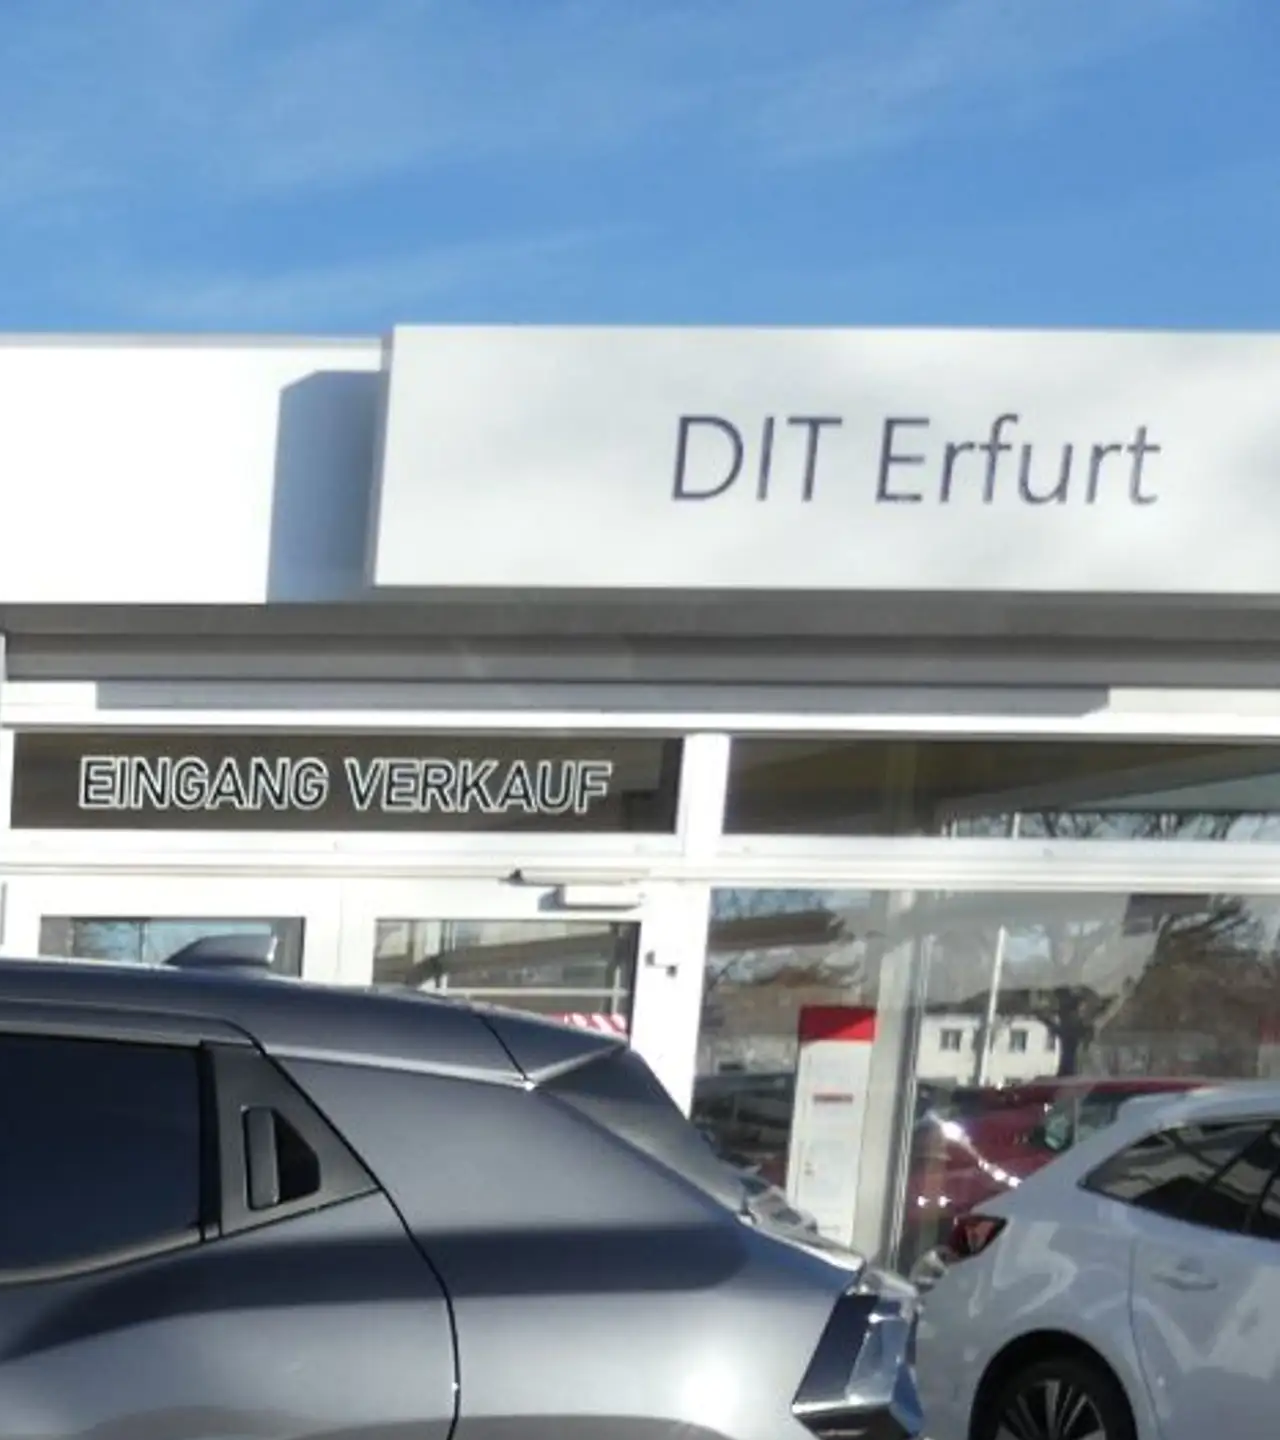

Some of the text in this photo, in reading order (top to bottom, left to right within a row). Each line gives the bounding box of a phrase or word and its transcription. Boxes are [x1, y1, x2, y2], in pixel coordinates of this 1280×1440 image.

[671, 412, 1161, 505] DIT Erfurt
[78, 755, 613, 815] EINGANG VERKAUF
